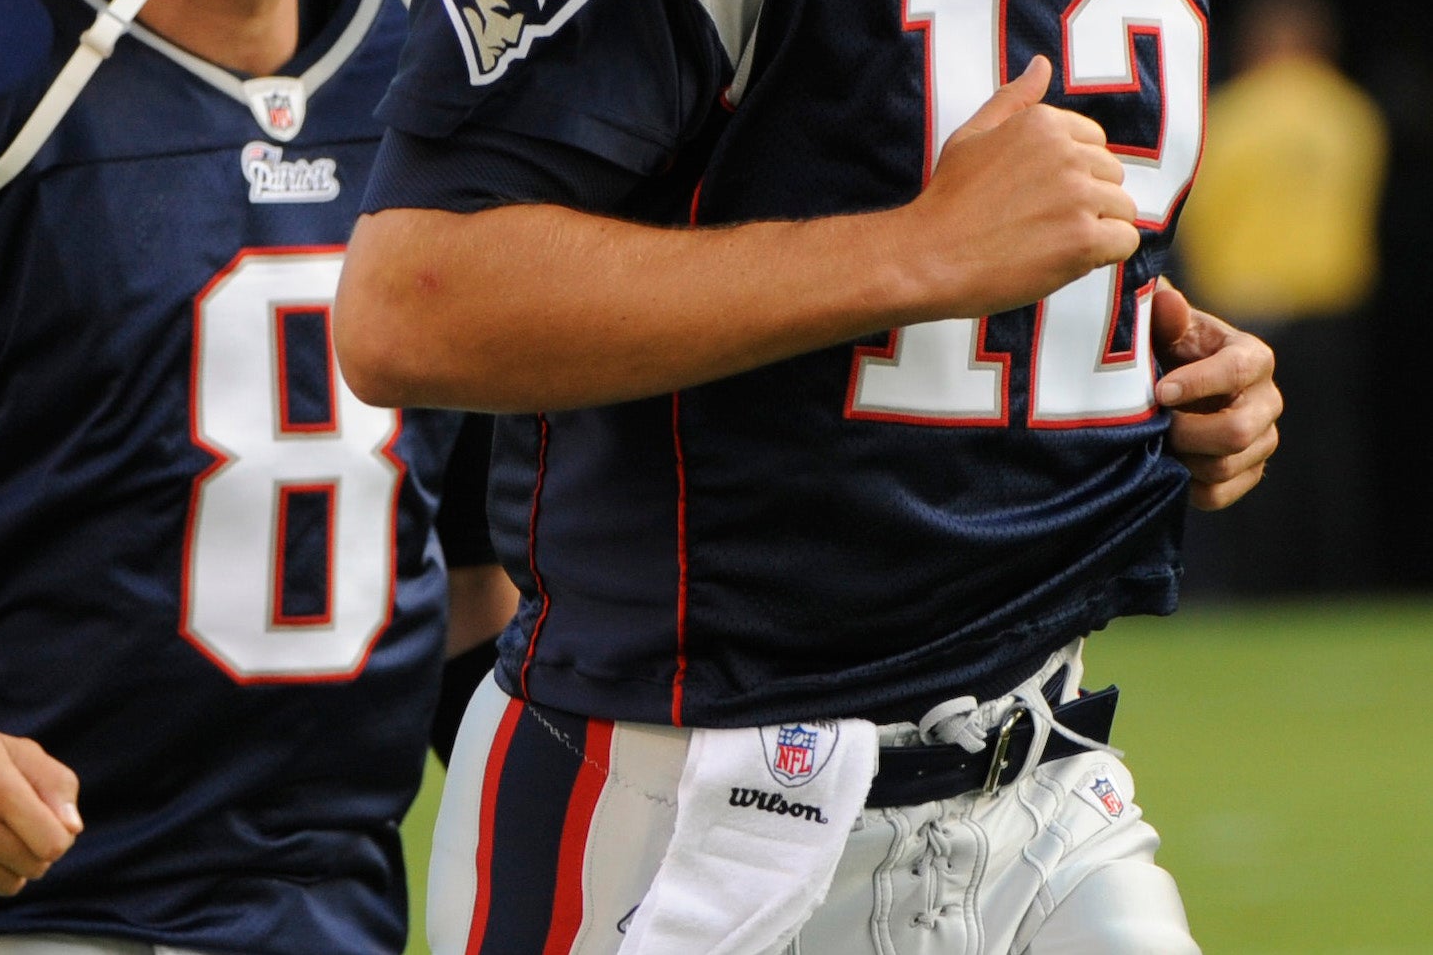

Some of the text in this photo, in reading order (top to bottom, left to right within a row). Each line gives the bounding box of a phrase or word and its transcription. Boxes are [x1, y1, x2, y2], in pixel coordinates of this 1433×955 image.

[178, 244, 407, 685] 8
[775, 745, 813, 775] NFL
[728, 787, 825, 823] Wilson
